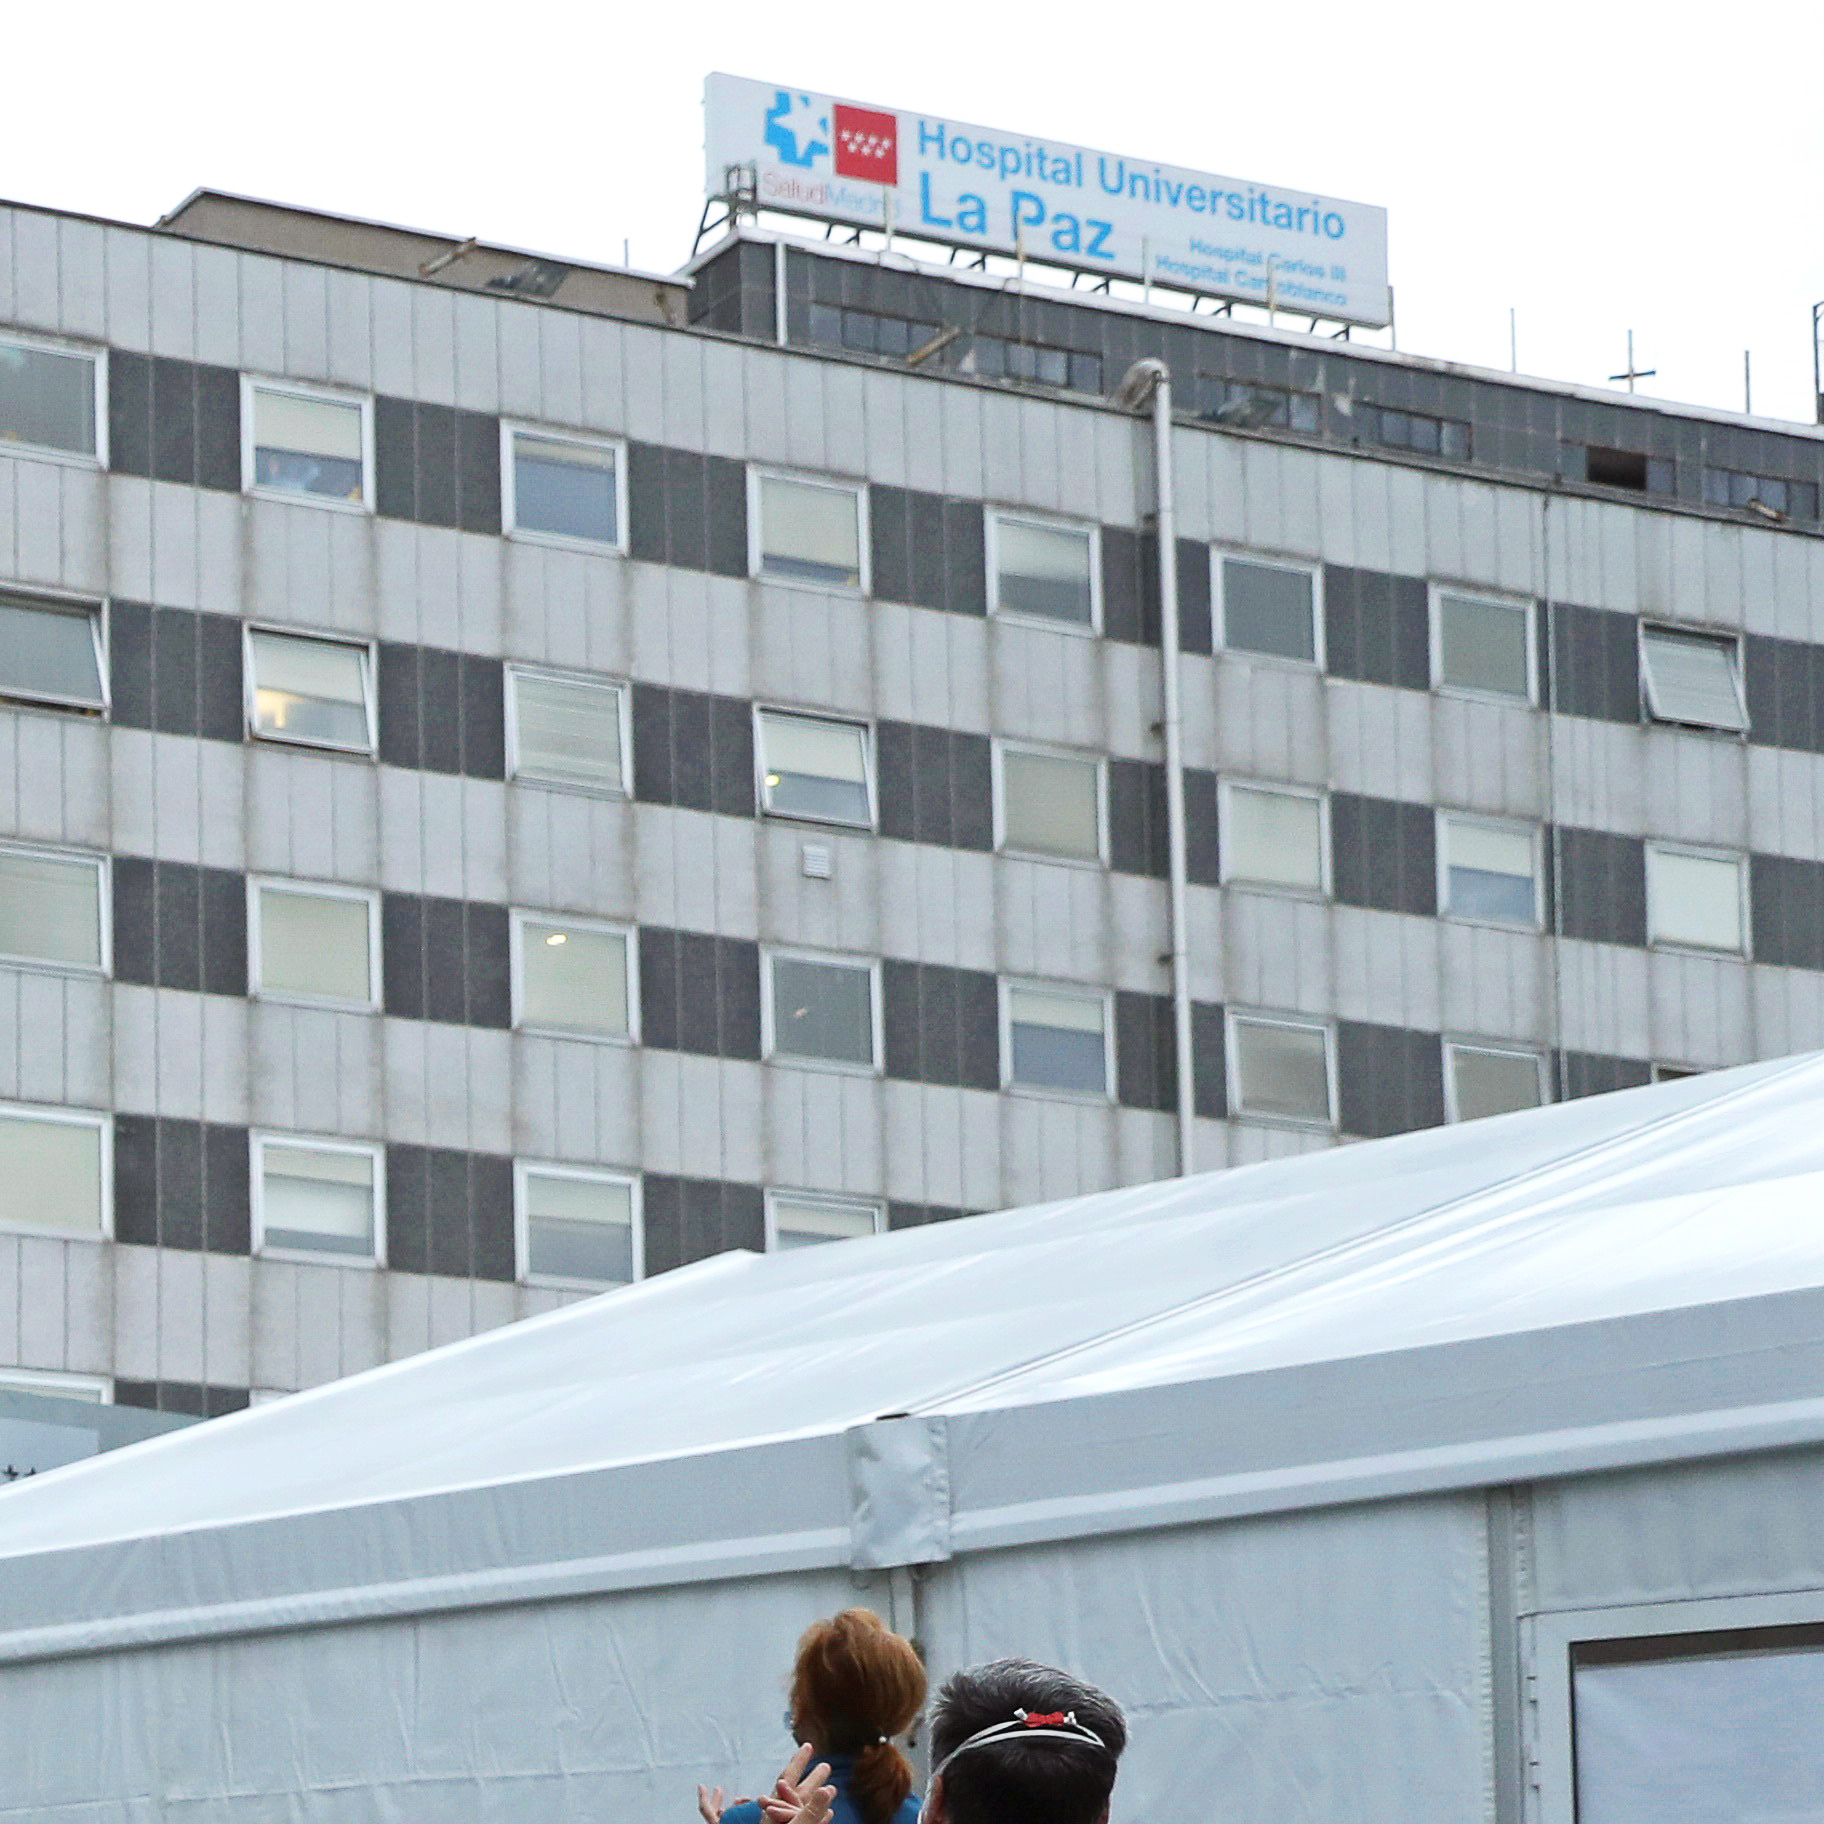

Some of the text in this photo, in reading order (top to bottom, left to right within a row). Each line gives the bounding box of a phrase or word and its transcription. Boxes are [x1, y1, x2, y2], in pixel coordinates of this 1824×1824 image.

[918, 119, 1345, 240] Hospital Universitario
[919, 171, 1116, 260] La Paz
